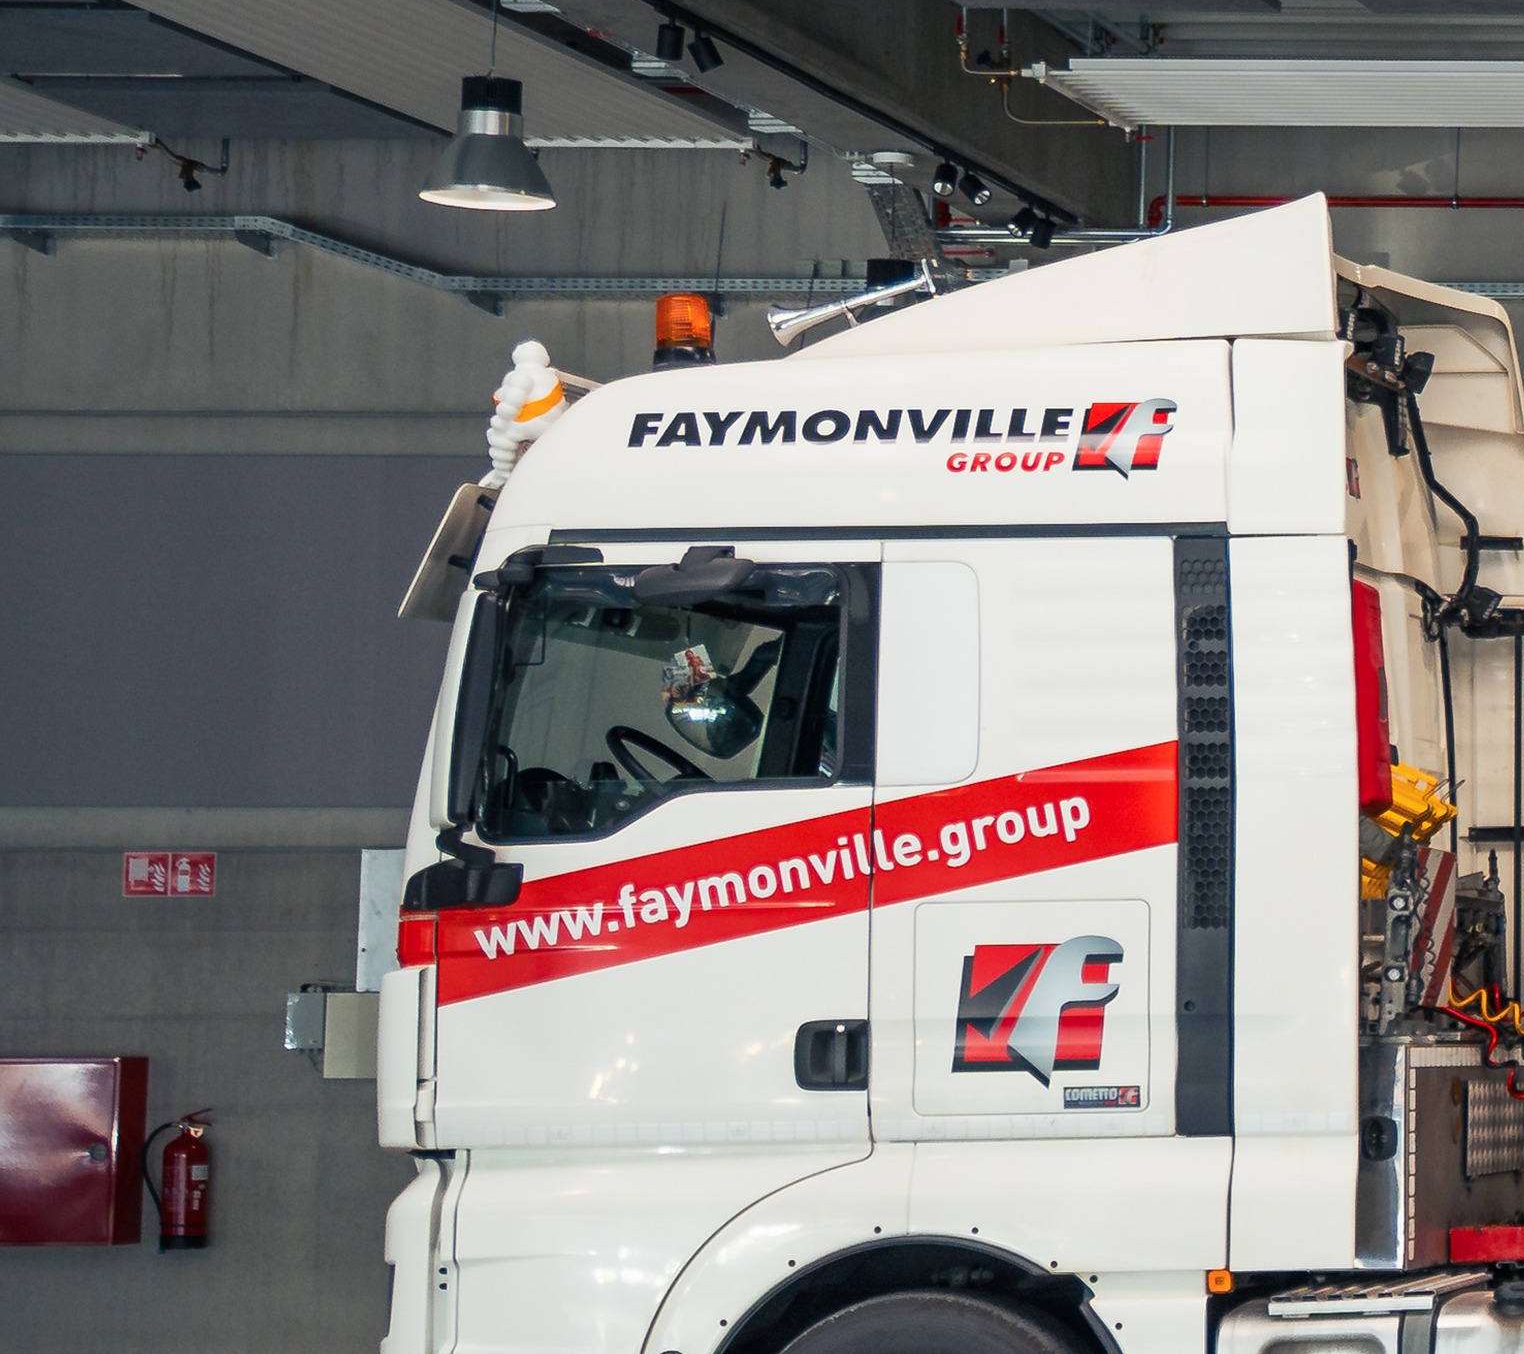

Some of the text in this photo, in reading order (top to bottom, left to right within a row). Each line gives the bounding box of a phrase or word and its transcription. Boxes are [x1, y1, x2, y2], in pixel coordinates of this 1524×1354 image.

[626, 407, 1075, 447] FAYMONVILLE
[945, 451, 1066, 473] GROUP
[473, 794, 1091, 960] www.faymonville.group
[1064, 1087, 1118, 1101] COMETTO
